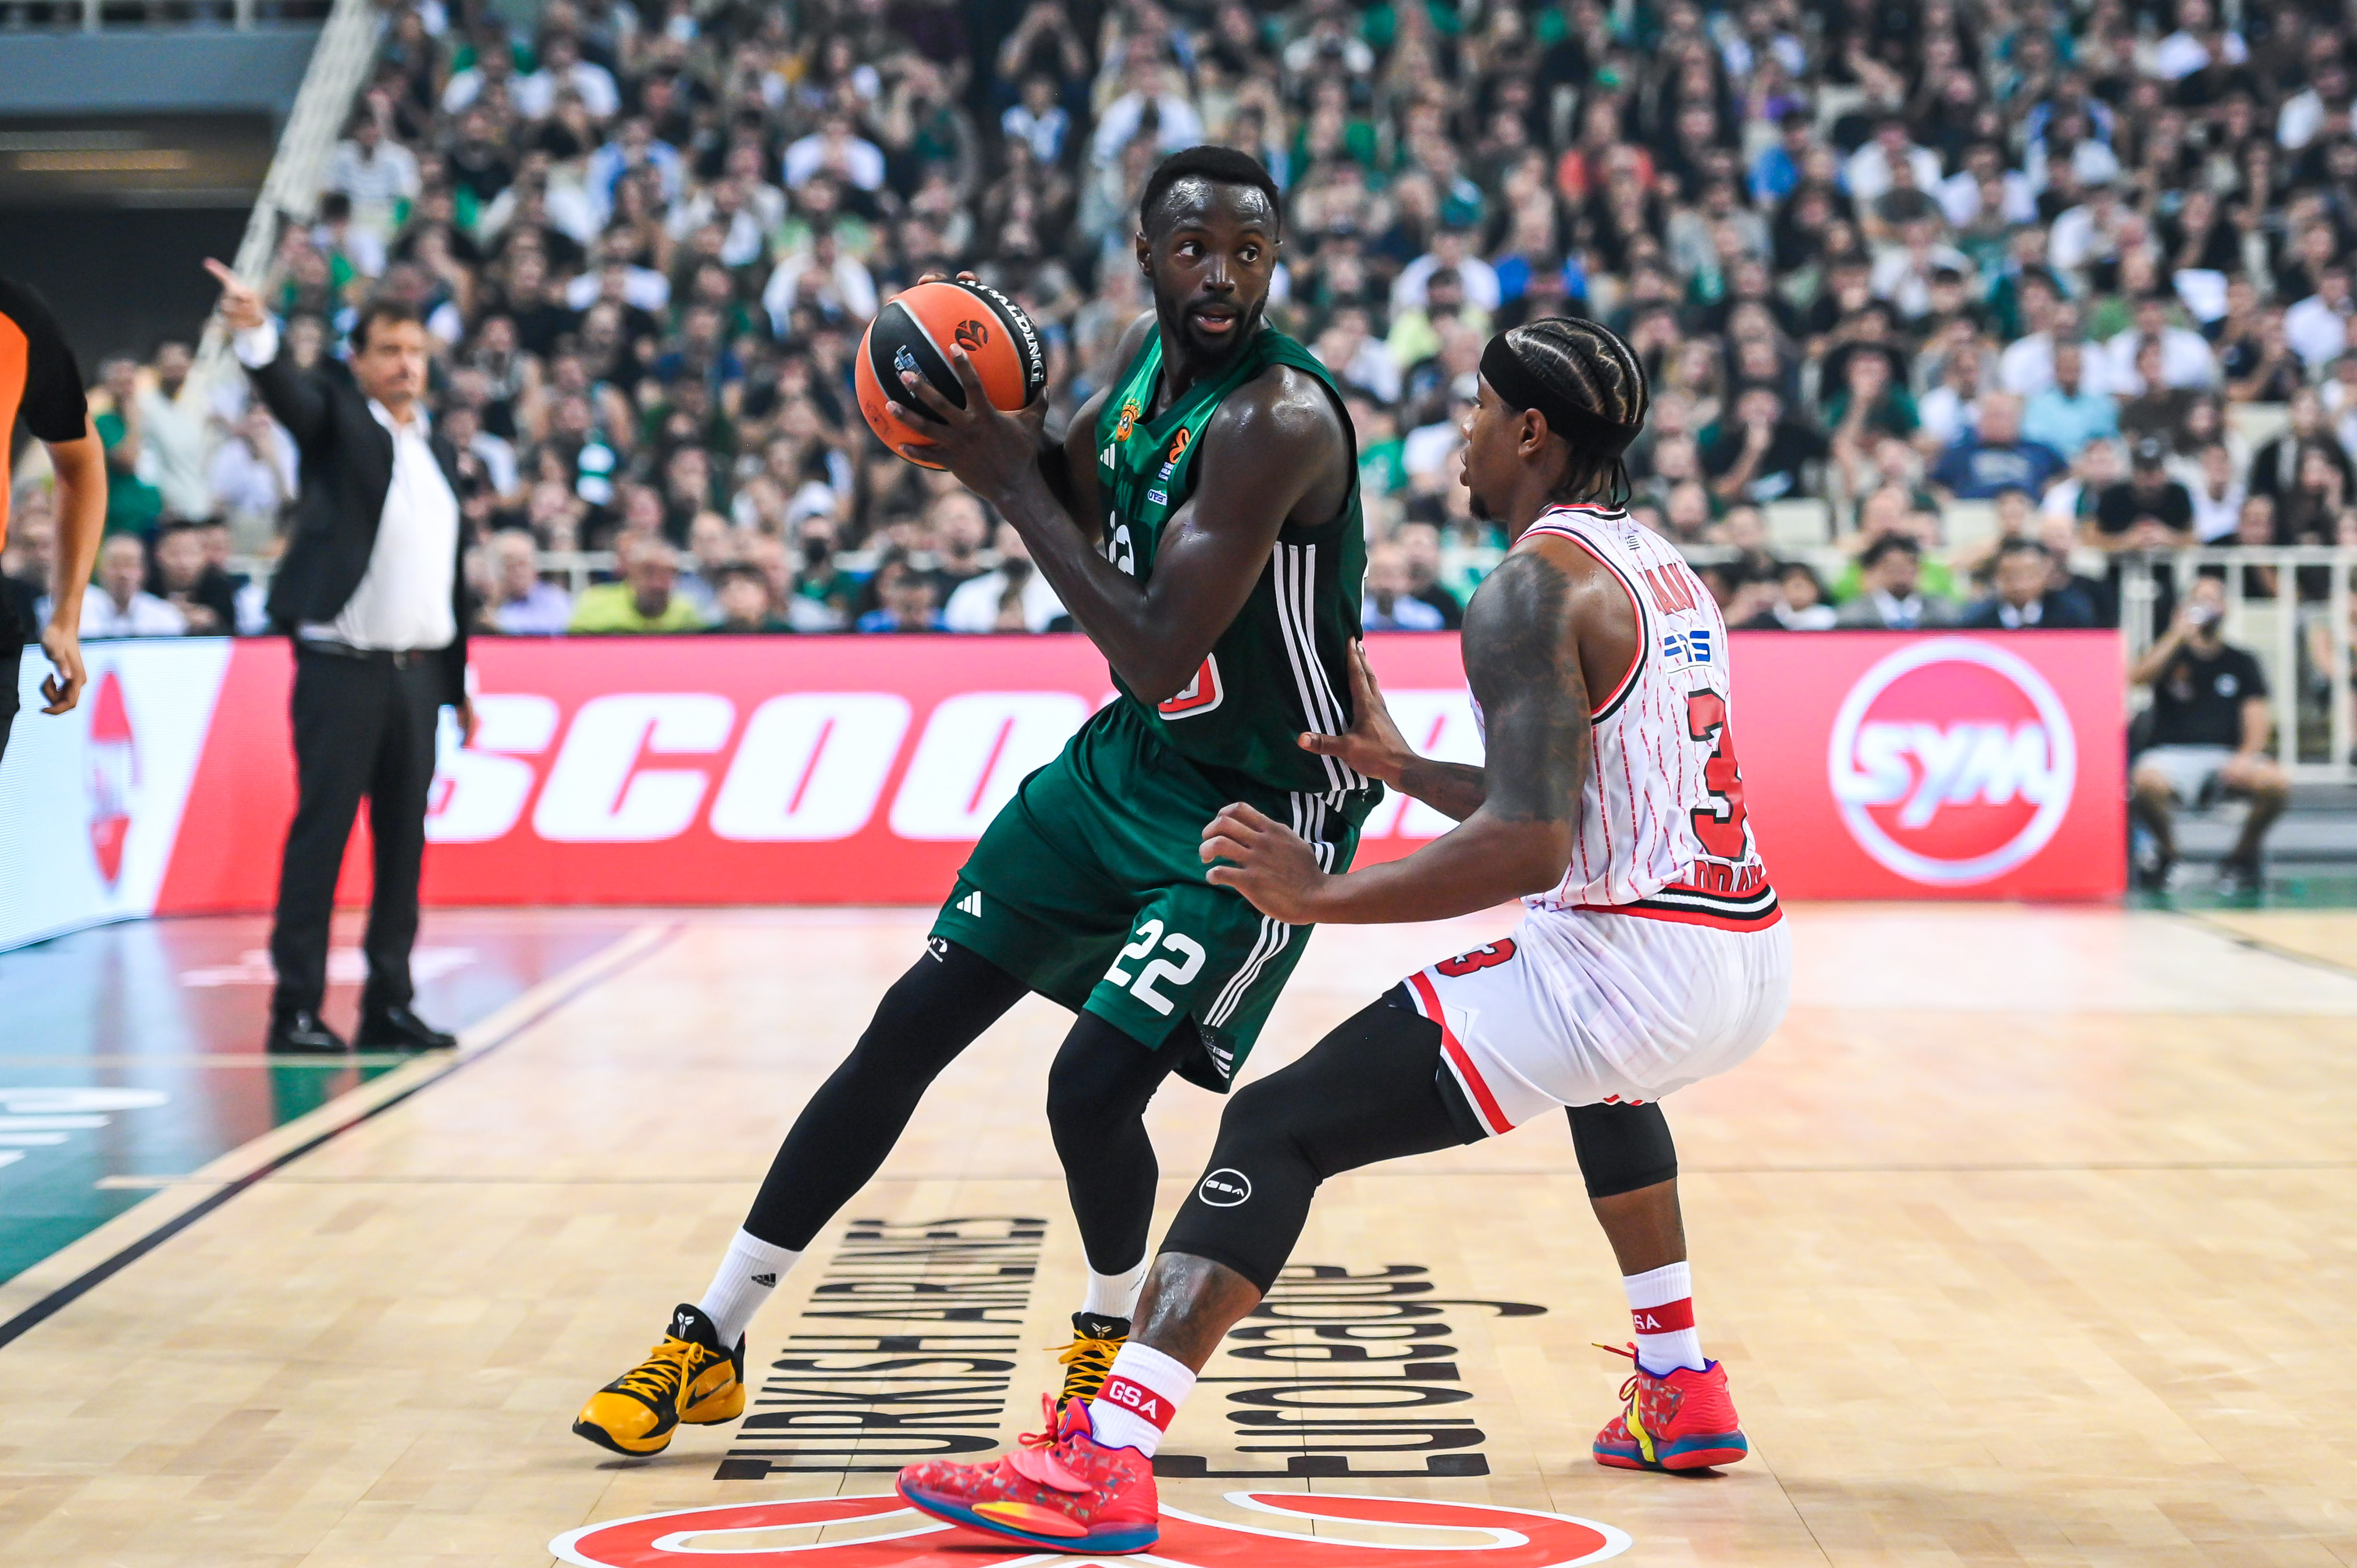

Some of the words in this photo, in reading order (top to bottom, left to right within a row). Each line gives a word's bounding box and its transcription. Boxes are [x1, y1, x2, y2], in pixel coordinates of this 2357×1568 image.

[959, 280, 1044, 387] ALDING
[1686, 687, 1747, 862] 3
[1838, 722, 2055, 829] SYM
[1103, 918, 1206, 1016] 22
[1434, 937, 1517, 978] 3
[801, 1217, 1049, 1324] AIRLINES
[1633, 1313, 1662, 1330] SA
[713, 1335, 1020, 1480] TURKISH
[1109, 1380, 1157, 1420] GSA
